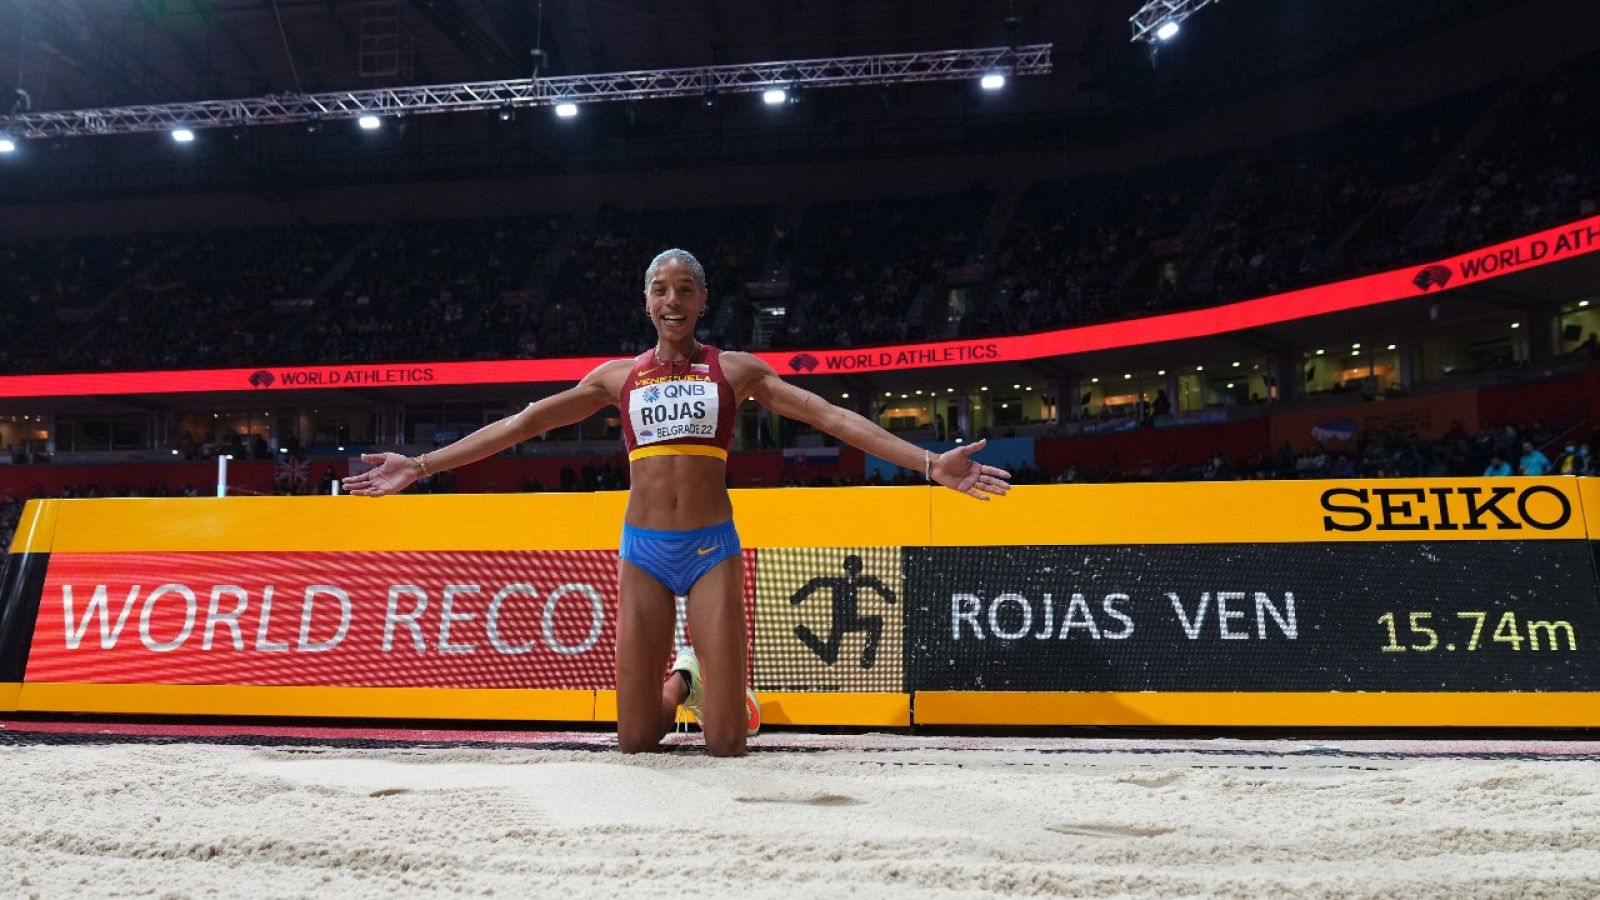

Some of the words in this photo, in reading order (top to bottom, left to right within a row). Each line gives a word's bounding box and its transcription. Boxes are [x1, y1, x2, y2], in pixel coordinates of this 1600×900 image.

[1460, 240, 1548, 278] WORLD
[826, 353, 892, 369] WORLD
[281, 370, 340, 385] WORLD
[664, 384, 705, 398] QNB
[641, 401, 706, 425] ROJAS
[657, 424, 700, 438] BELGRADE
[701, 424, 713, 435] 22
[1321, 485, 1572, 532] SEIKO
[62, 583, 353, 653] WORLD
[382, 582, 689, 654] RECO
[950, 592, 1135, 642] ROJAS
[1165, 592, 1298, 641] VEN
[1377, 611, 1577, 653] 15.74m
